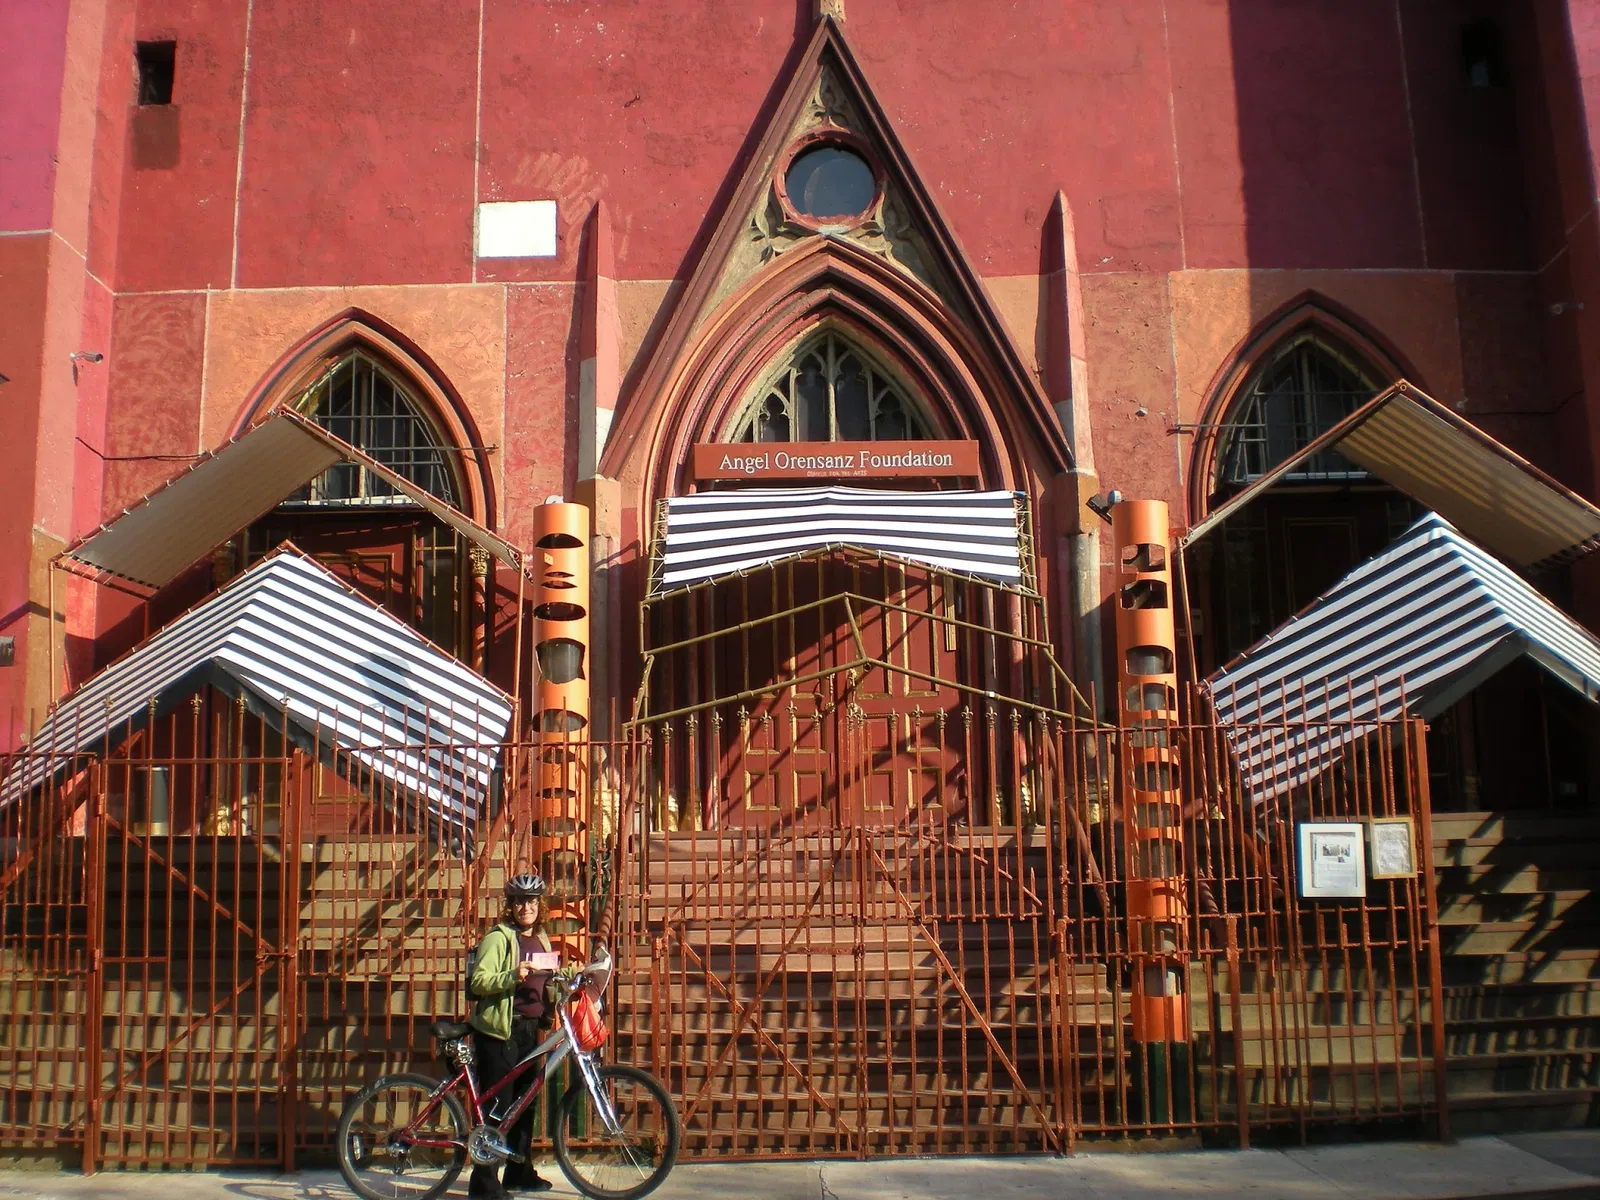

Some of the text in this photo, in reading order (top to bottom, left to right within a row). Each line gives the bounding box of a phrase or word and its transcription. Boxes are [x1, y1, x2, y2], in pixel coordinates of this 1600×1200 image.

[719, 450, 953, 474] Angel Orensanz Foundation
